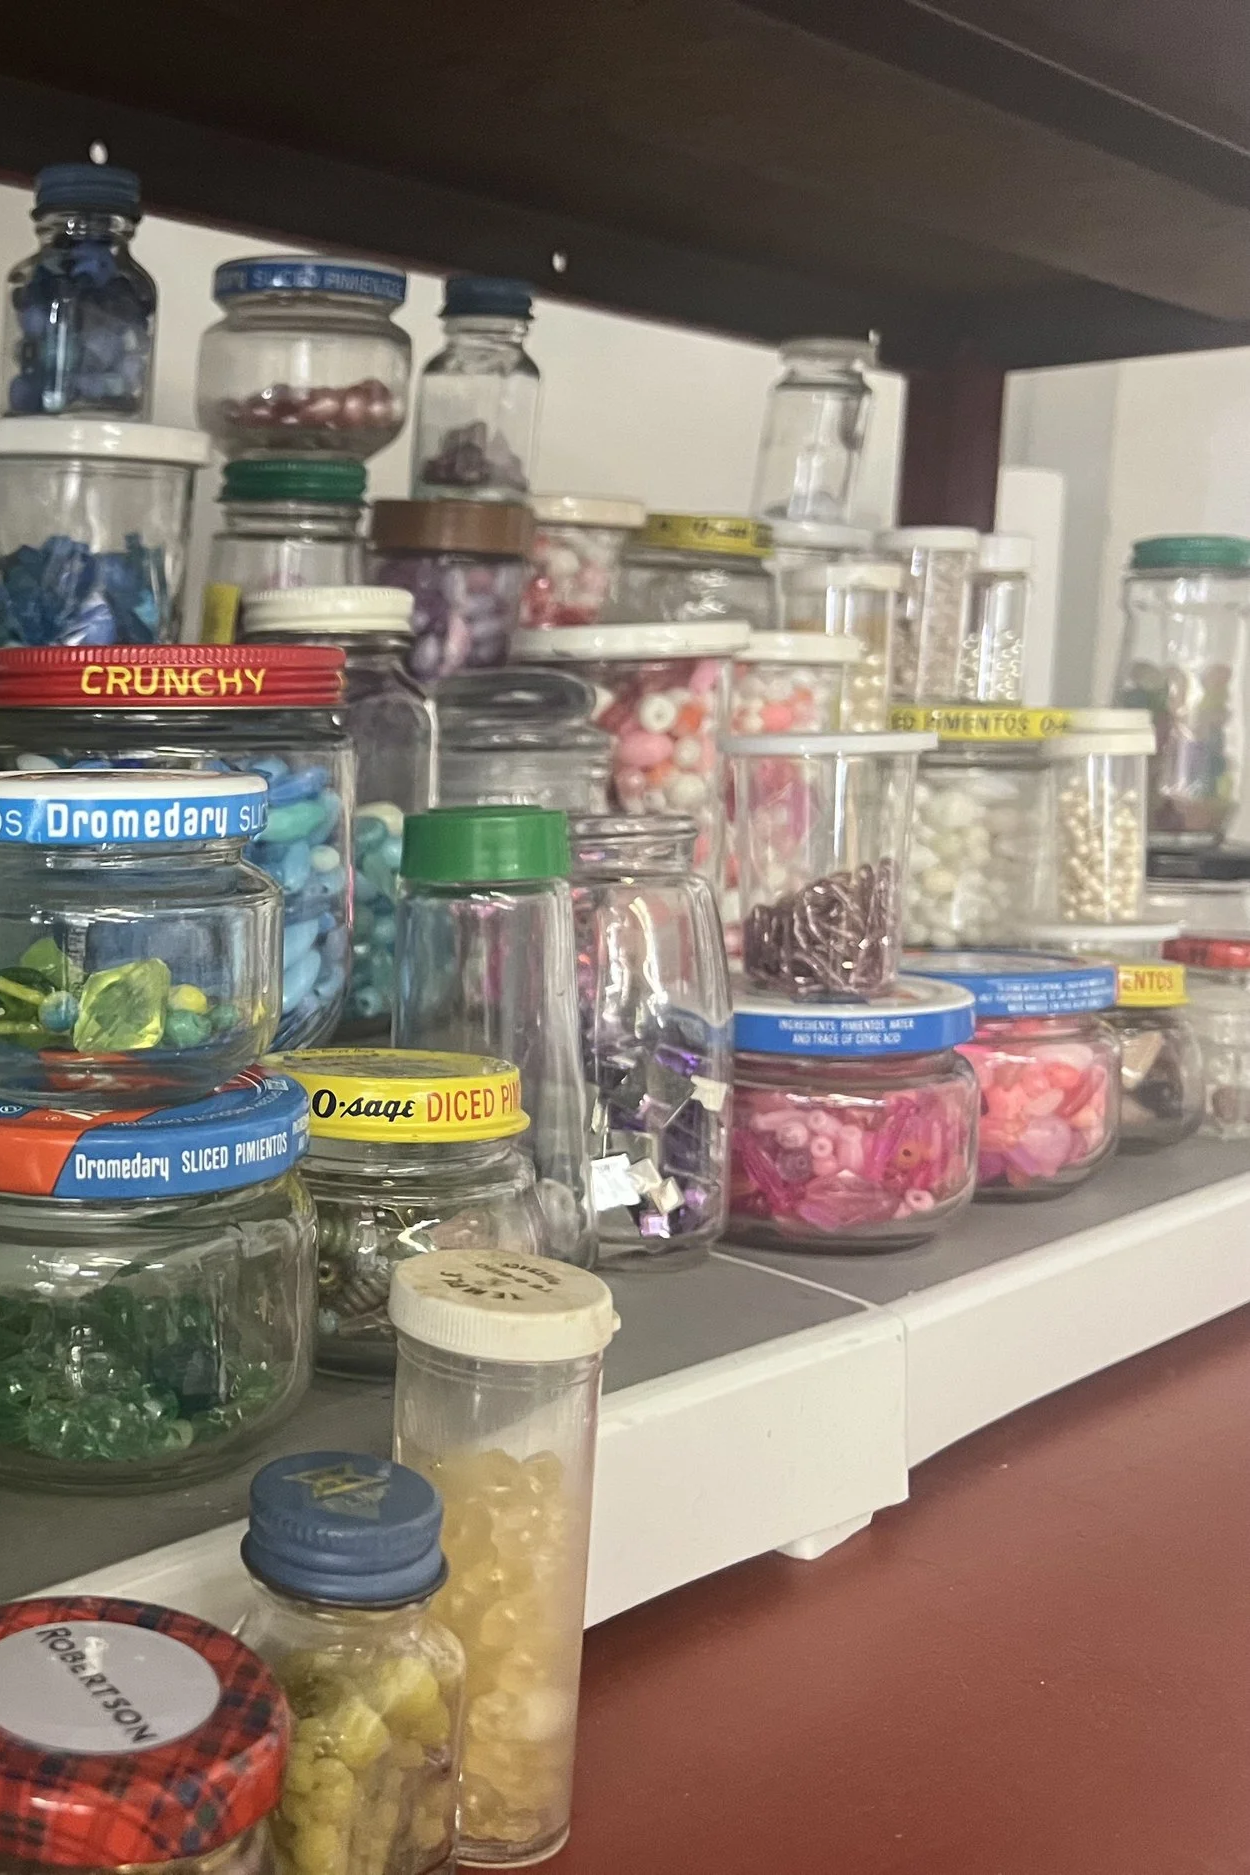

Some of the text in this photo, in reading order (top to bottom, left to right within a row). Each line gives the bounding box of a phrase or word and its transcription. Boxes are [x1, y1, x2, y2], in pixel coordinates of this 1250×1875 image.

[80, 665, 267, 696] CRUNCHY
[47, 803, 229, 838] Dromedary
[792, 1032, 811, 1046] AND
[841, 1033, 852, 1045] OF
[426, 1087, 495, 1122] DICED
[75, 1153, 170, 1181] Dromedary
[181, 1147, 229, 1174] SLICED
[235, 1131, 288, 1166] PIMIENTOS
[36, 1626, 157, 1744] ROBERTSON
